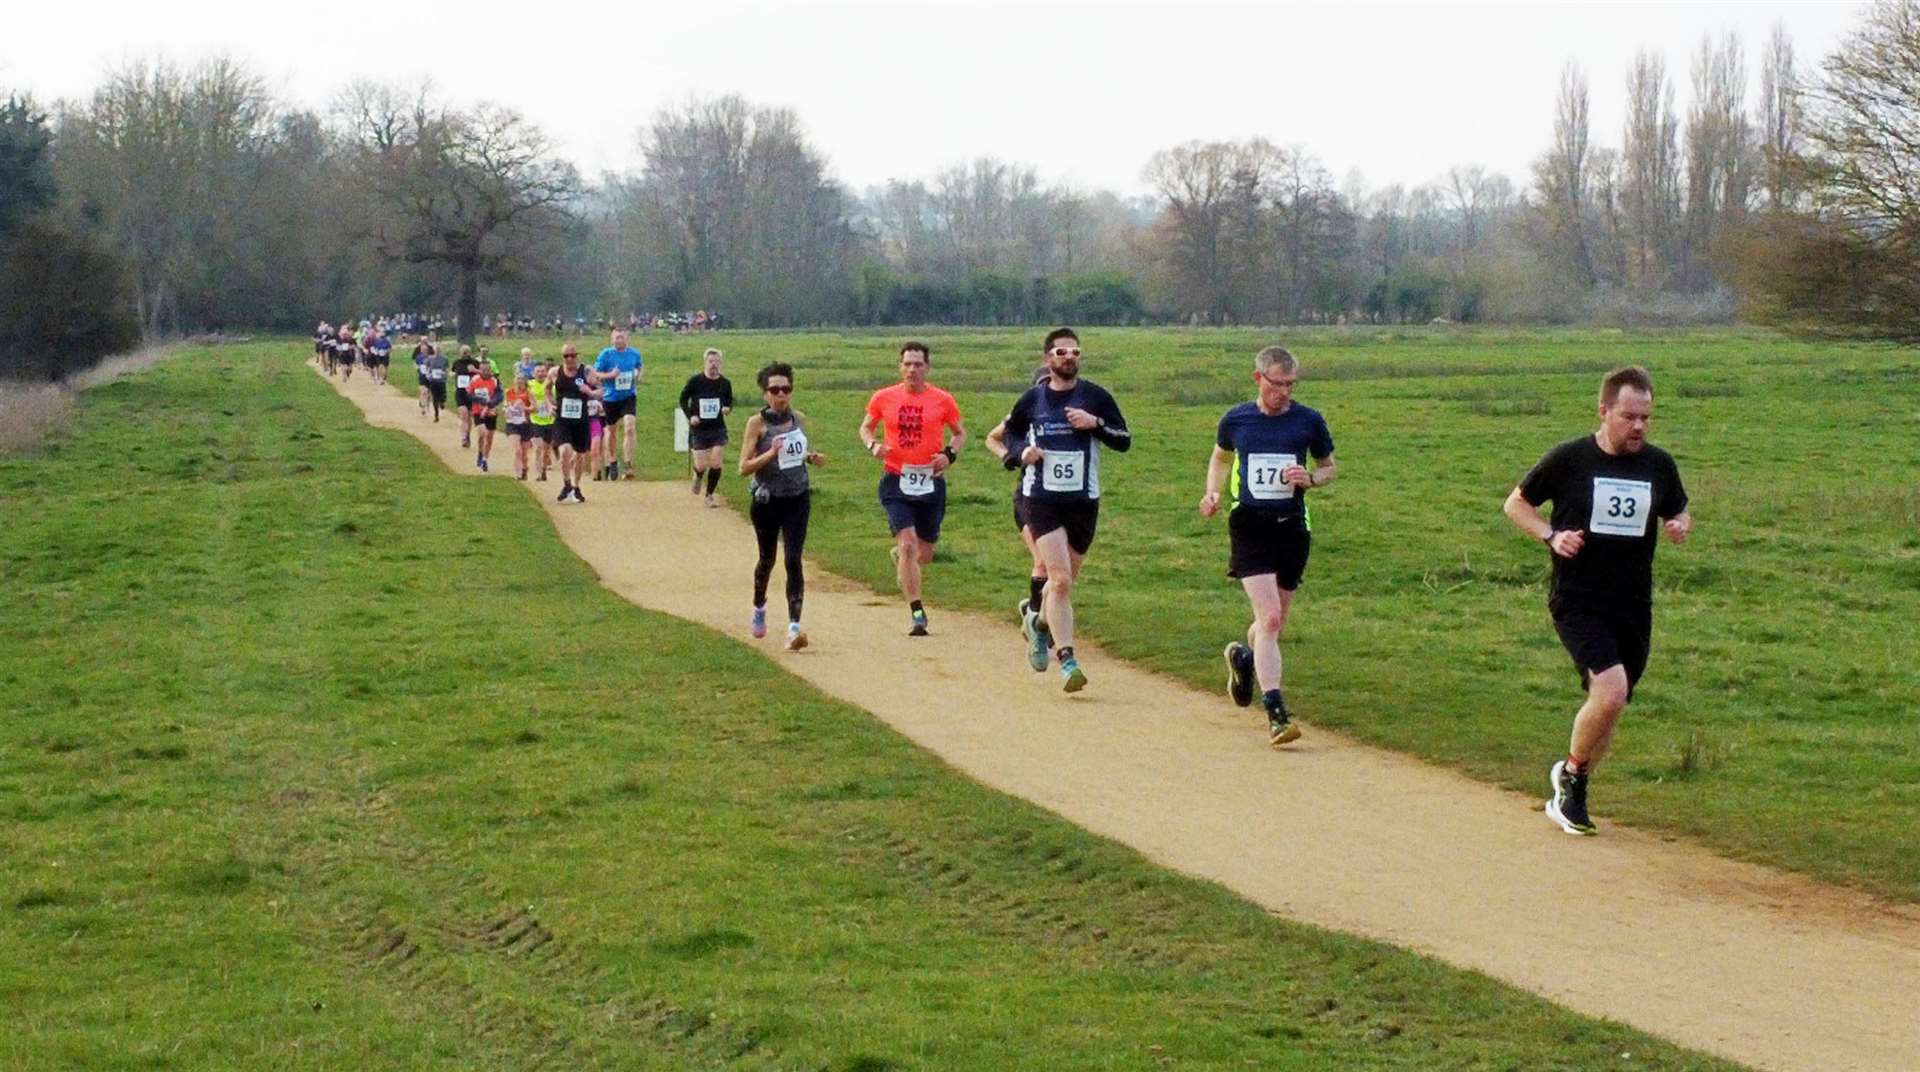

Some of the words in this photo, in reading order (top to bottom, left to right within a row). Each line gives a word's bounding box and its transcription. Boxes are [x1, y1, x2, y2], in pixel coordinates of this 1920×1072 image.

[898, 405, 923, 414] ATH
[898, 431, 922, 439] ATH
[786, 441, 803, 456] 40
[1053, 464, 1074, 479] 65
[908, 473, 927, 486] 97
[1607, 496, 1636, 518] 33
